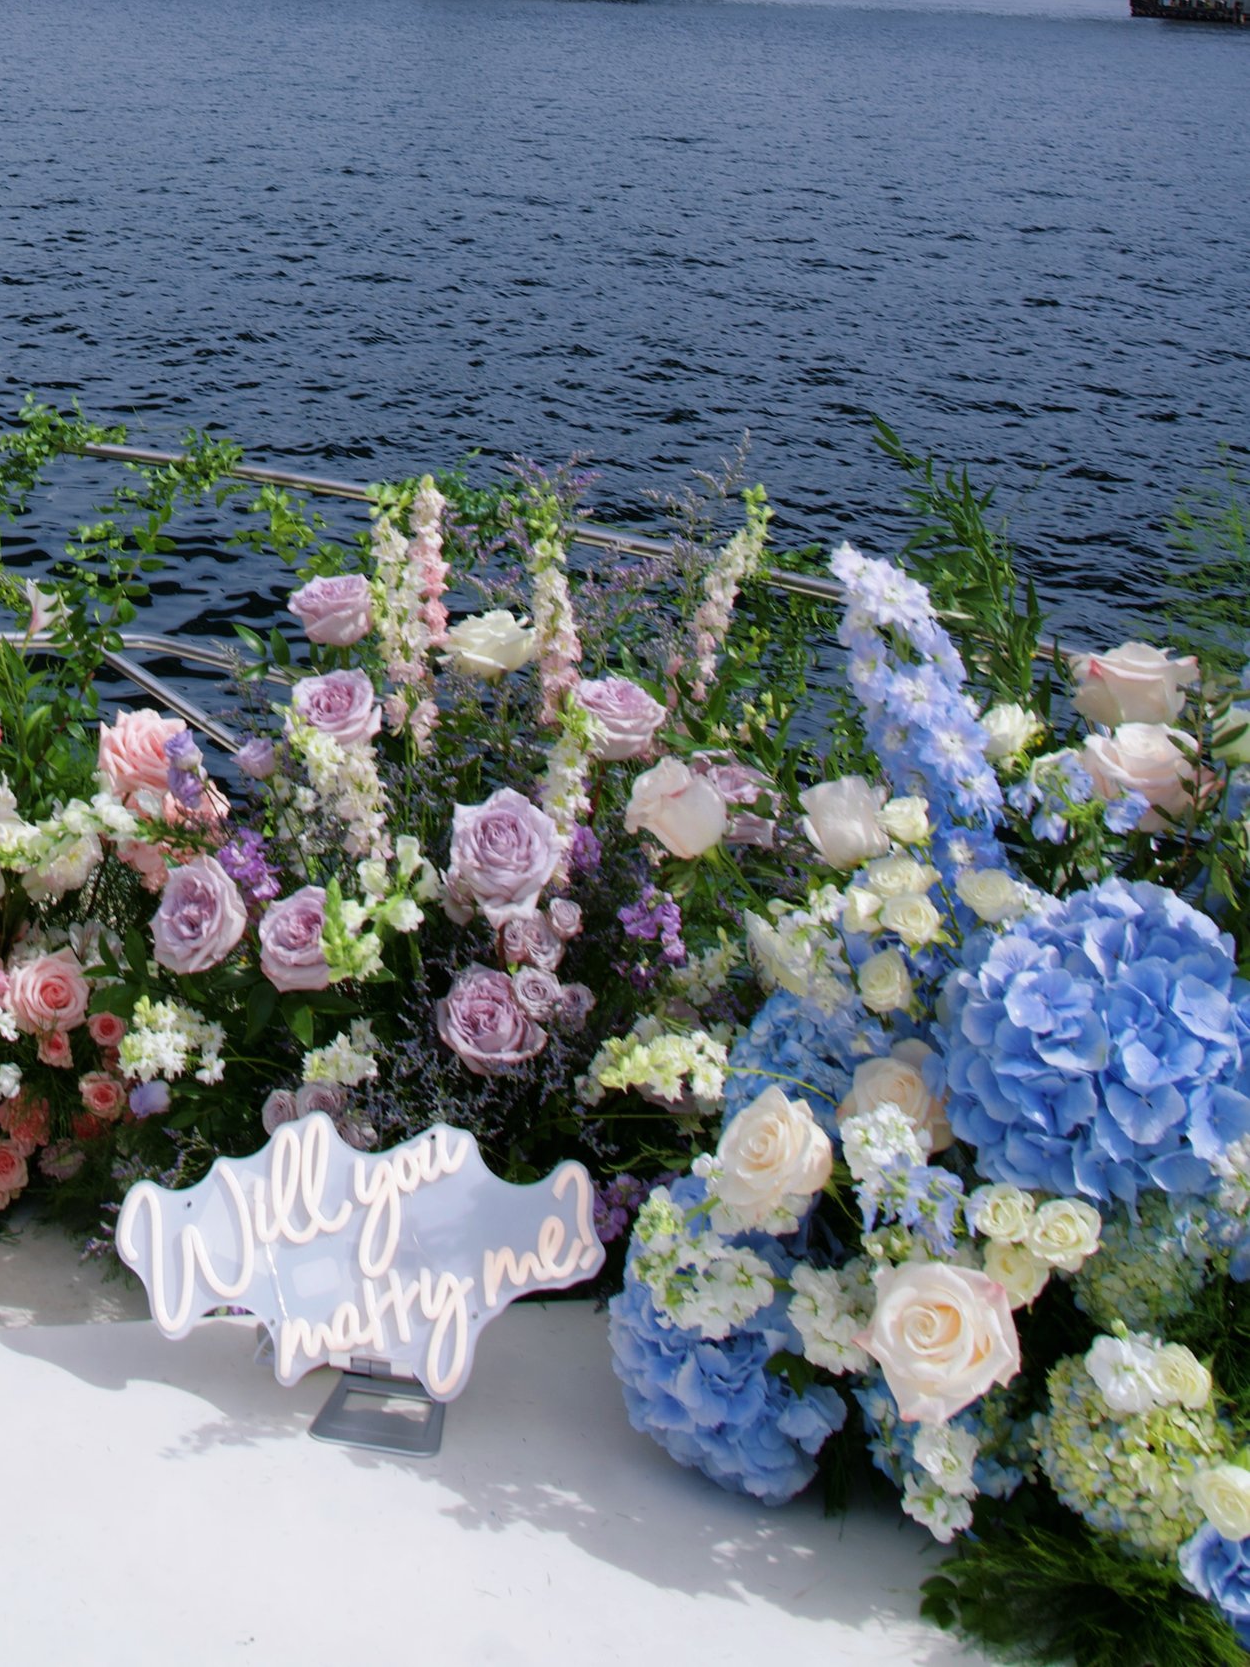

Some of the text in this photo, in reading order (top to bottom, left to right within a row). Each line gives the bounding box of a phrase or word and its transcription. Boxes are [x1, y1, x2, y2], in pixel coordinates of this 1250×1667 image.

[122, 1116, 469, 1333] Will you
[279, 1164, 600, 1395] marry me?
